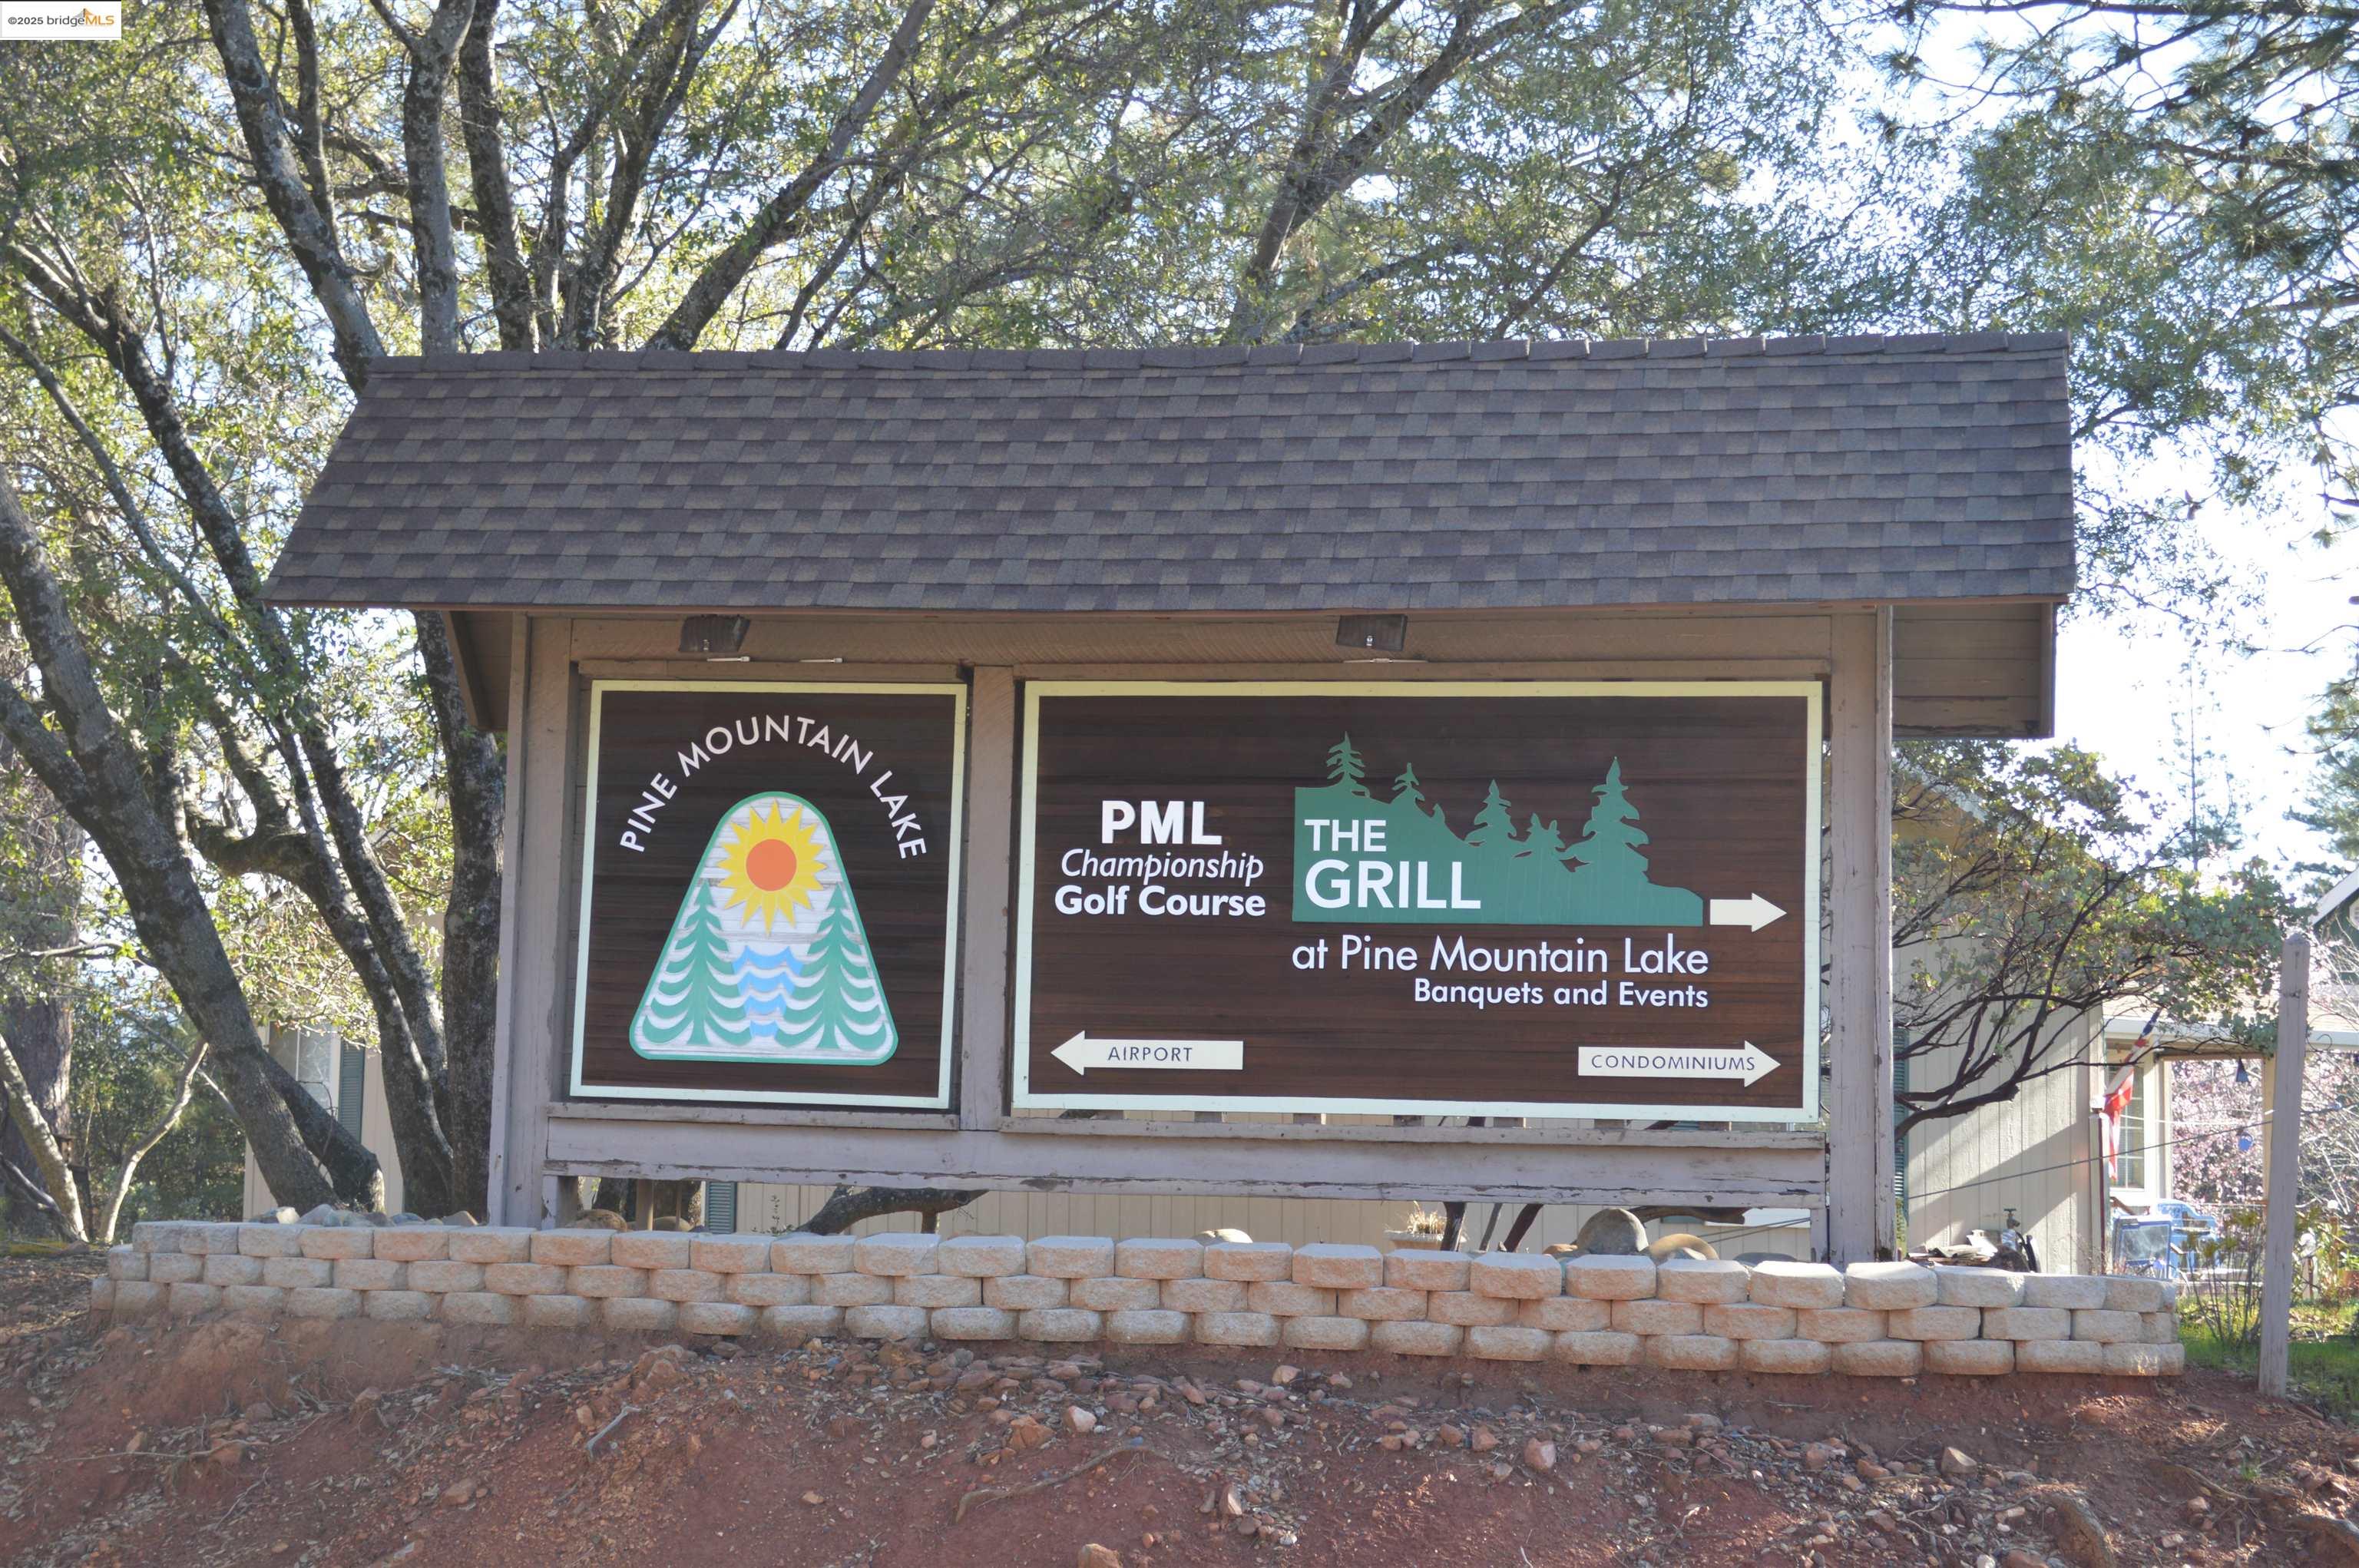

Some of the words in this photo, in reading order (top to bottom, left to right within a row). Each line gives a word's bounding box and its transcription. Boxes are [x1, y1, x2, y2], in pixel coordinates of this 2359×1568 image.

[620, 772, 677, 852] PINE
[677, 715, 873, 776] MOUNTAIN
[869, 770, 927, 859] LAKE
[1101, 800, 1223, 845] PML
[1304, 819, 1387, 852] THE
[1061, 849, 1264, 886] Championship
[1305, 859, 1481, 909] GRILL
[1054, 885, 1130, 915] Golf
[1138, 886, 1266, 917] Course
[1292, 938, 1328, 970] at
[1342, 934, 1418, 971] Pine
[1430, 935, 1608, 973] Mountain
[1624, 933, 1709, 974] Lake
[1414, 978, 1543, 1010] Banquets
[1553, 980, 1607, 1005] and
[1619, 982, 1709, 1007] Events
[1107, 1047, 1193, 1062] AIRPORT
[1590, 1054, 1756, 1071] CONDOMINIUMS
